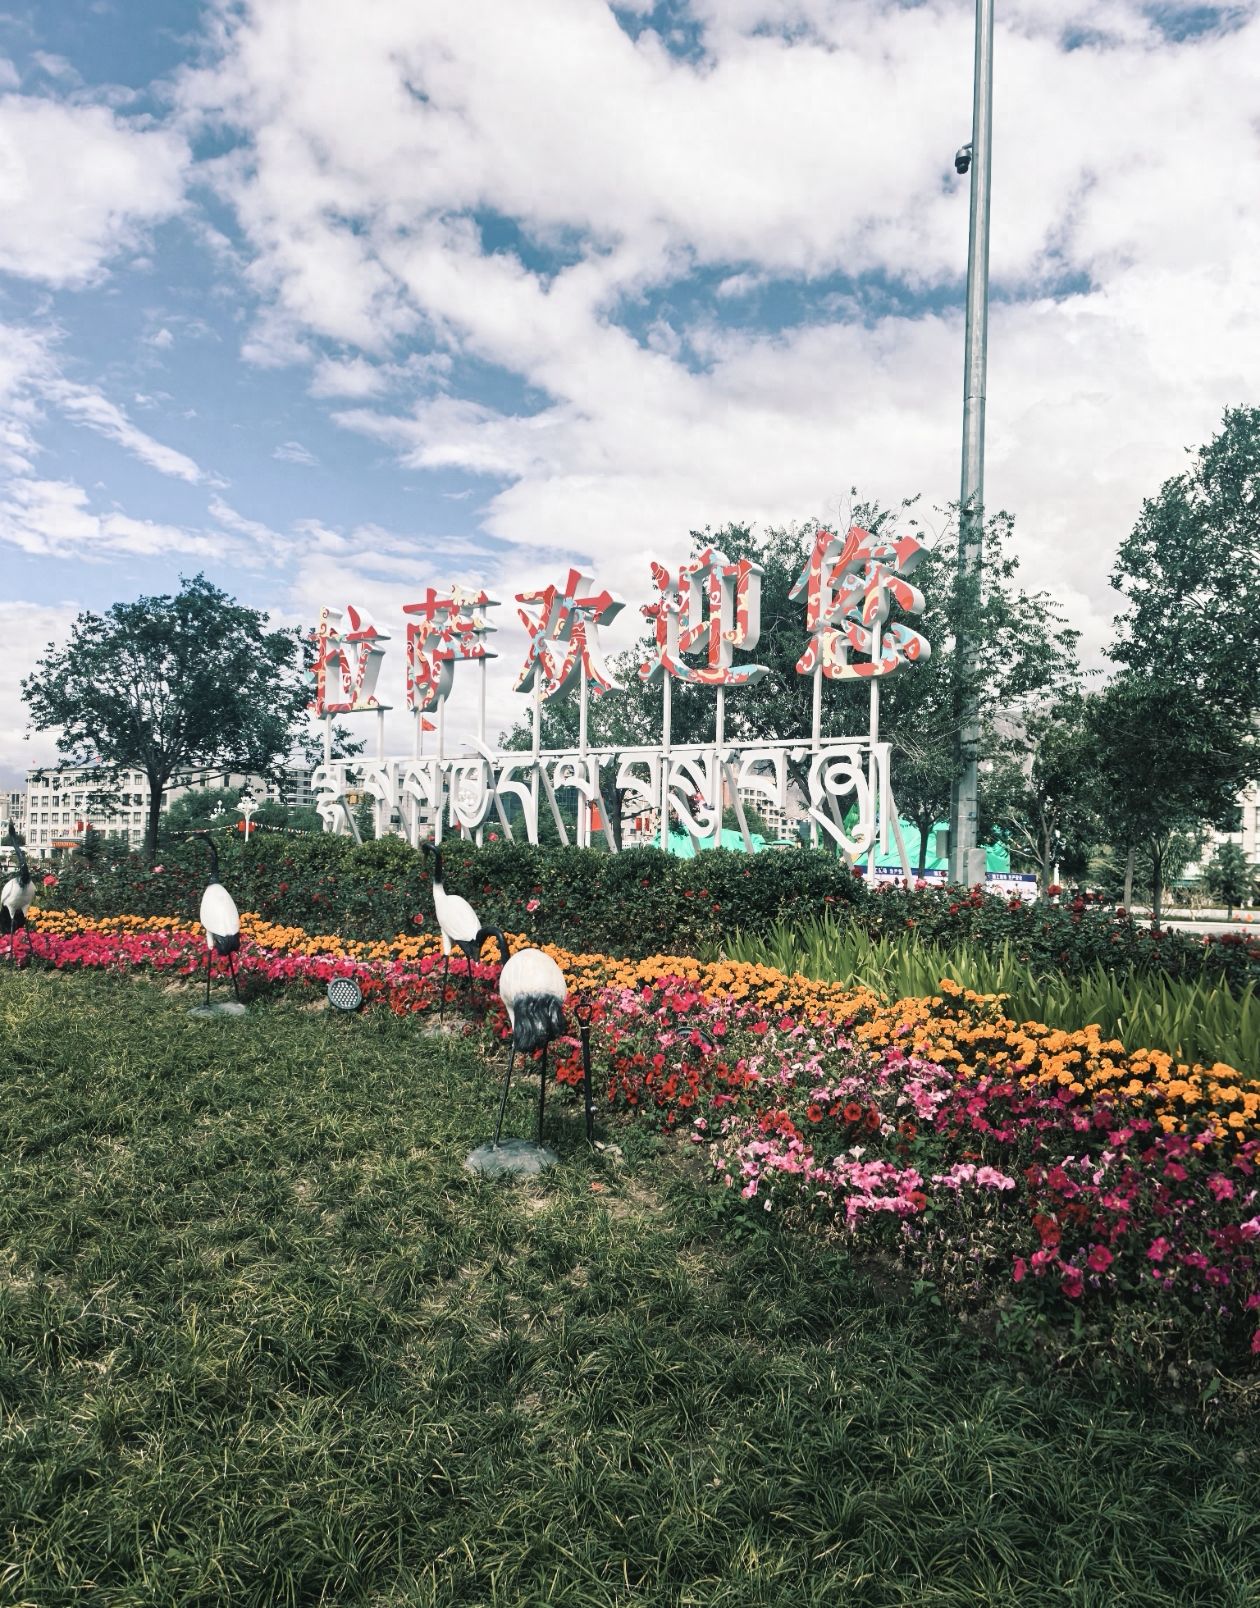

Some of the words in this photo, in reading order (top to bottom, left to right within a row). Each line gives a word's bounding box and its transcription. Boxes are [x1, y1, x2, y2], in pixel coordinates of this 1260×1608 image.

[307, 526, 931, 719] 拉萨欢迎您
